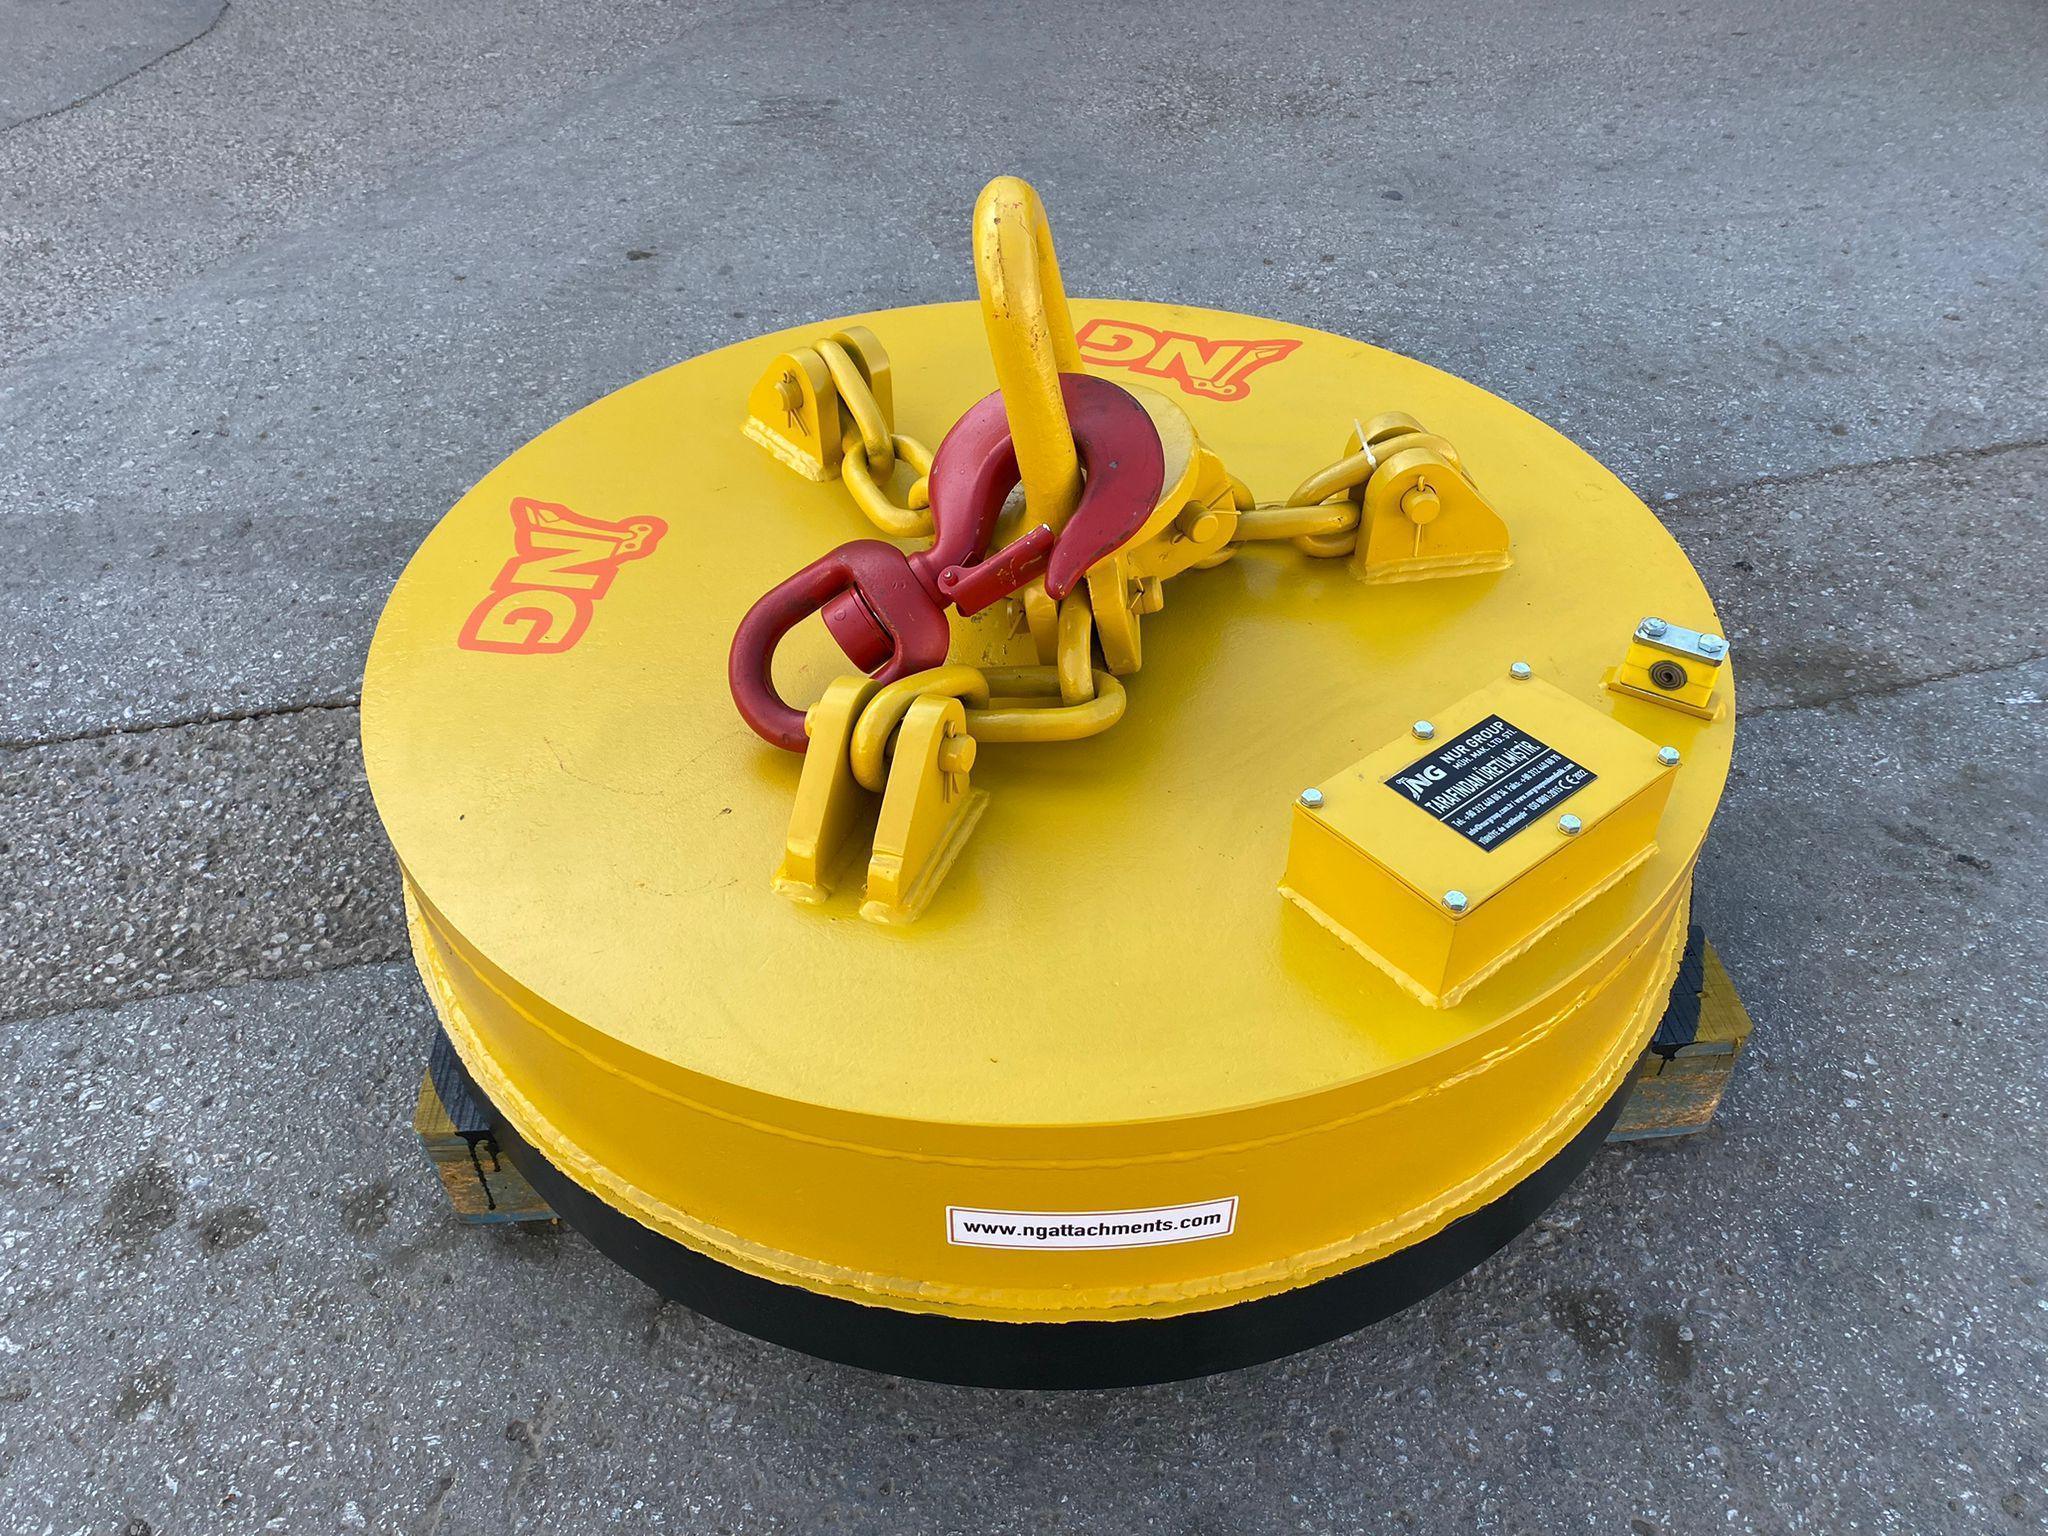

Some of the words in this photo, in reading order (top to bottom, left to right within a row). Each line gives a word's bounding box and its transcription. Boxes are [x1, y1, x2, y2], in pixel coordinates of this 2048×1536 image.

[1076, 319, 1251, 388] NG
[458, 525, 622, 655] NG
[1439, 745, 1470, 764] NUR
[1466, 721, 1503, 747] GROUP
[1452, 757, 1473, 769] MÜH.
[1470, 746, 1490, 758] MAK.
[1487, 737, 1505, 748] LTD.
[1425, 773, 1486, 813] TARAFINDAN
[1473, 741, 1540, 780] ÜRETİLMİŞTİR.
[1472, 803, 1486, 813] 312
[1527, 767, 1541, 776] 312
[963, 1213, 1222, 1240] www.ngattachments.com
